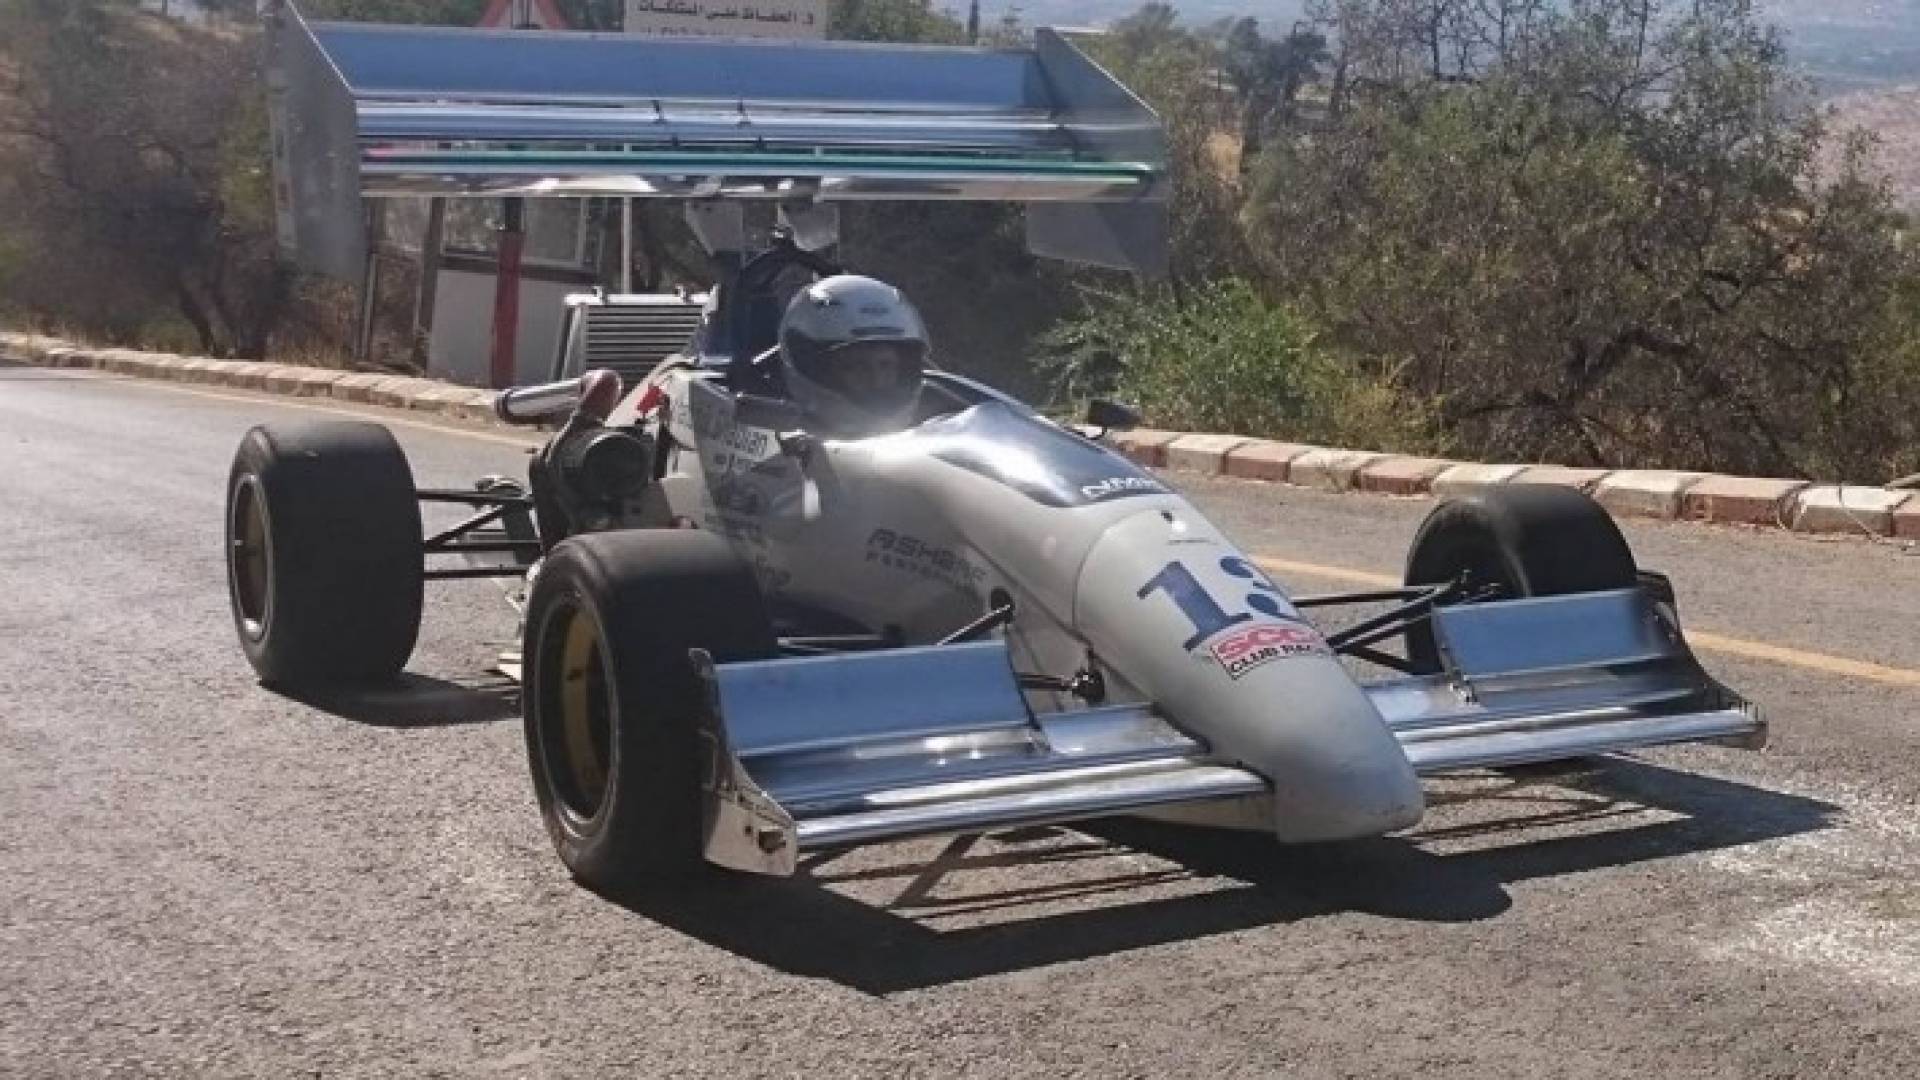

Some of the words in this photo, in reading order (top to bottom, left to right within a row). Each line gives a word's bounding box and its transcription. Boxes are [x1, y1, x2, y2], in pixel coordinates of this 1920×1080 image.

[1136, 556, 1304, 653] 13
[1217, 623, 1318, 659] SCC
[1230, 646, 1279, 673] CLUB
